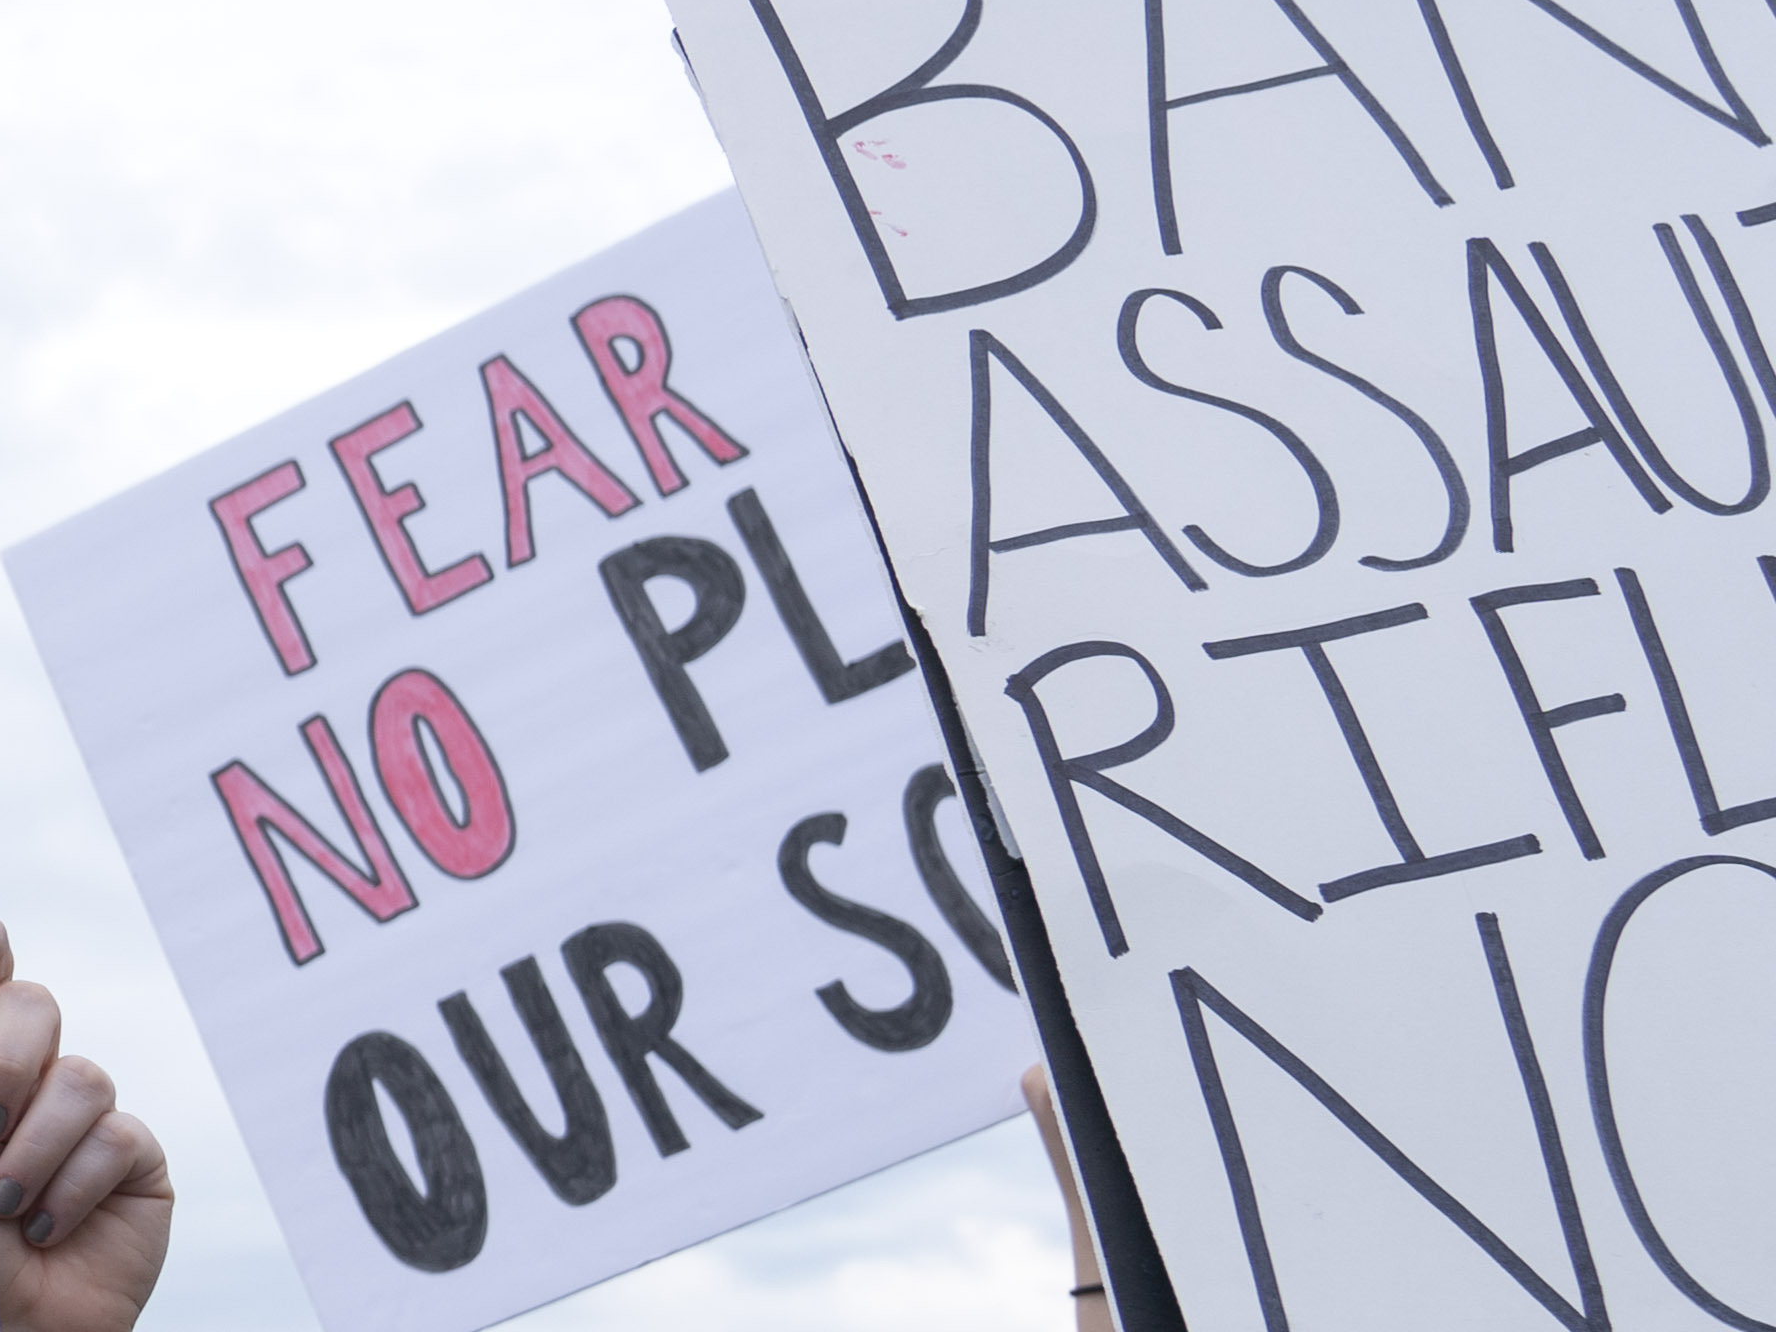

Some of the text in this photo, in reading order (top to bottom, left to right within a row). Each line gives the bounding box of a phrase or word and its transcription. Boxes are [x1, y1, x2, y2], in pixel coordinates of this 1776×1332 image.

[209, 296, 750, 676] FEAR
[968, 203, 1776, 637] ASSAU
[211, 668, 516, 965] NO
[1005, 556, 1776, 959] RIFL
[324, 920, 765, 1273] OUR
